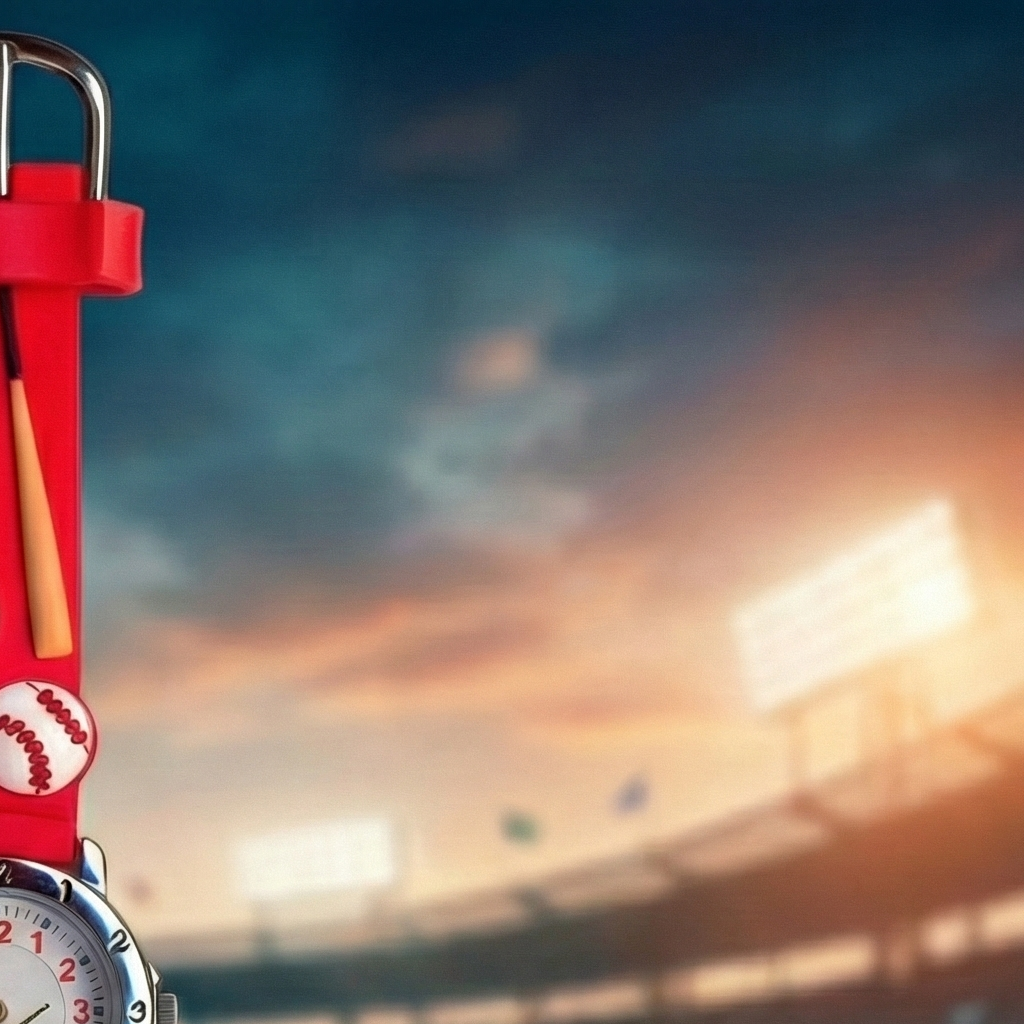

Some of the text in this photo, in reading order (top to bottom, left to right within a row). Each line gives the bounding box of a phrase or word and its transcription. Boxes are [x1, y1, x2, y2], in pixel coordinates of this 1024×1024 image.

[61, 879, 72, 902] 1
[30, 931, 43, 954] 1
[110, 929, 130, 955] 2
[59, 958, 76, 982] 2
[73, 999, 89, 1024] 3
[129, 1000, 146, 1022] 3
